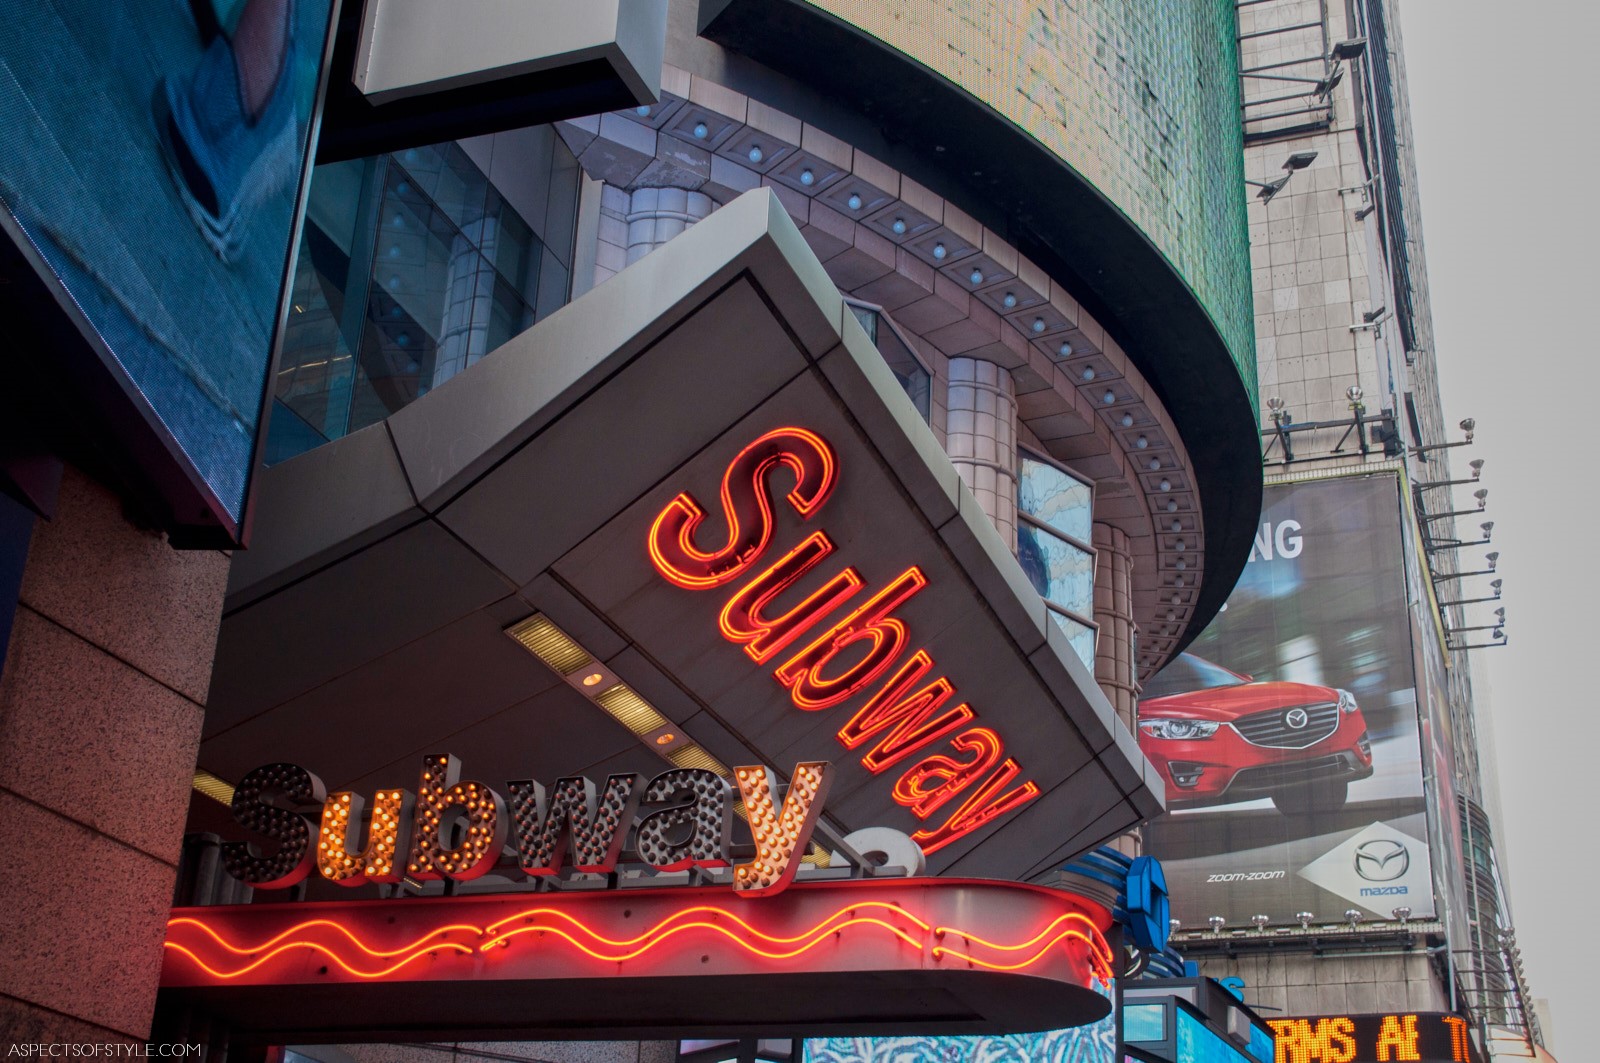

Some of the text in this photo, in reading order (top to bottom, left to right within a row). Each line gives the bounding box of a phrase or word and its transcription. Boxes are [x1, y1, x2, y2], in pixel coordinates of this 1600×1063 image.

[646, 425, 1041, 857] Subway
[221, 751, 834, 898] Subway
[1206, 869, 1286, 884] zoom-zoom
[1359, 885, 1409, 898] mazda
